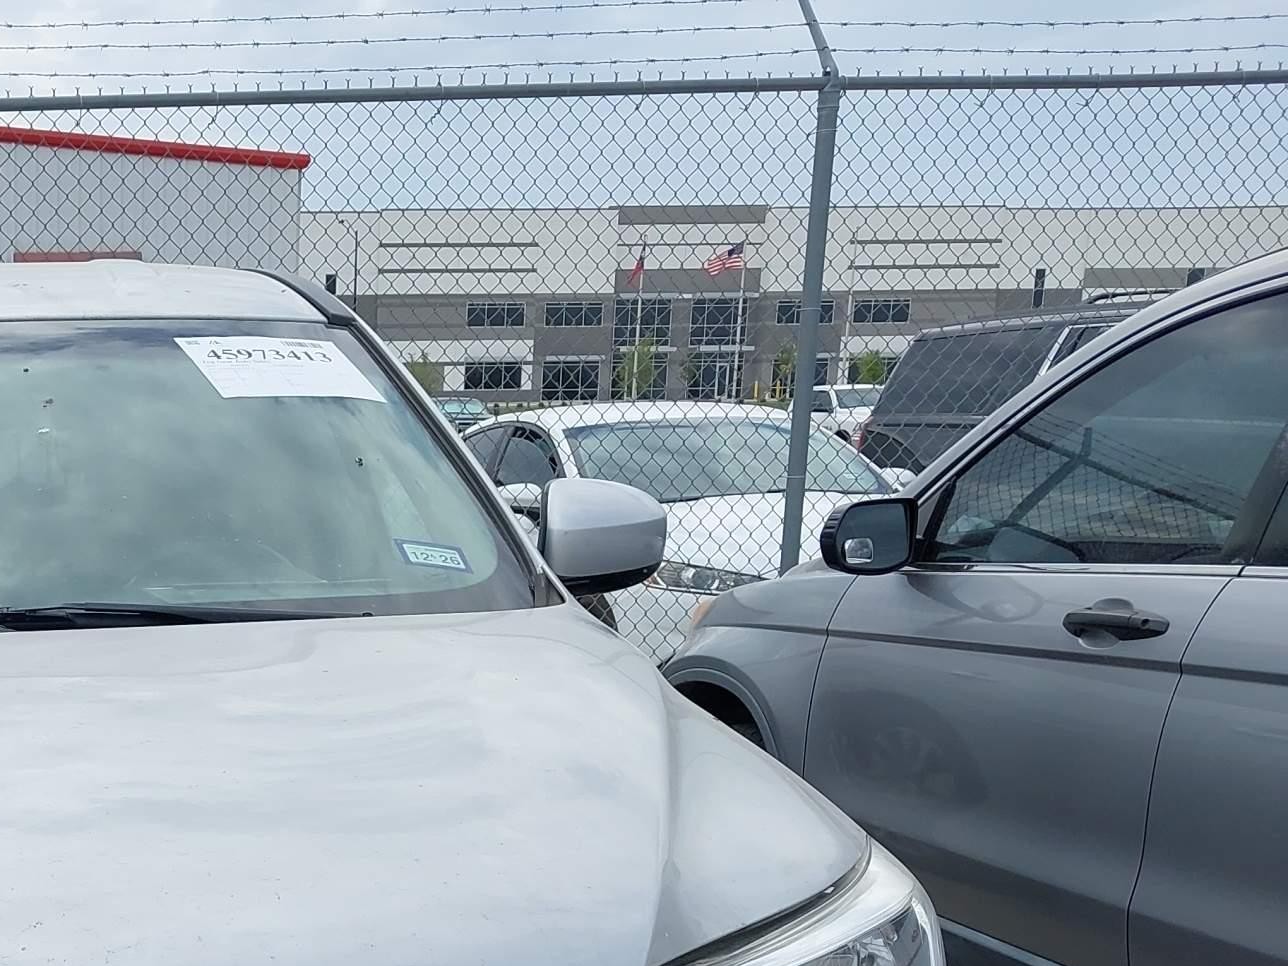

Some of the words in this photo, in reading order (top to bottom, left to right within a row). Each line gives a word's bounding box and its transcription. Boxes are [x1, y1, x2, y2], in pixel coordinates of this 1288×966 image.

[207, 348, 332, 363] 45973413
[410, 551, 432, 562] 12
[439, 554, 461, 565] 26
